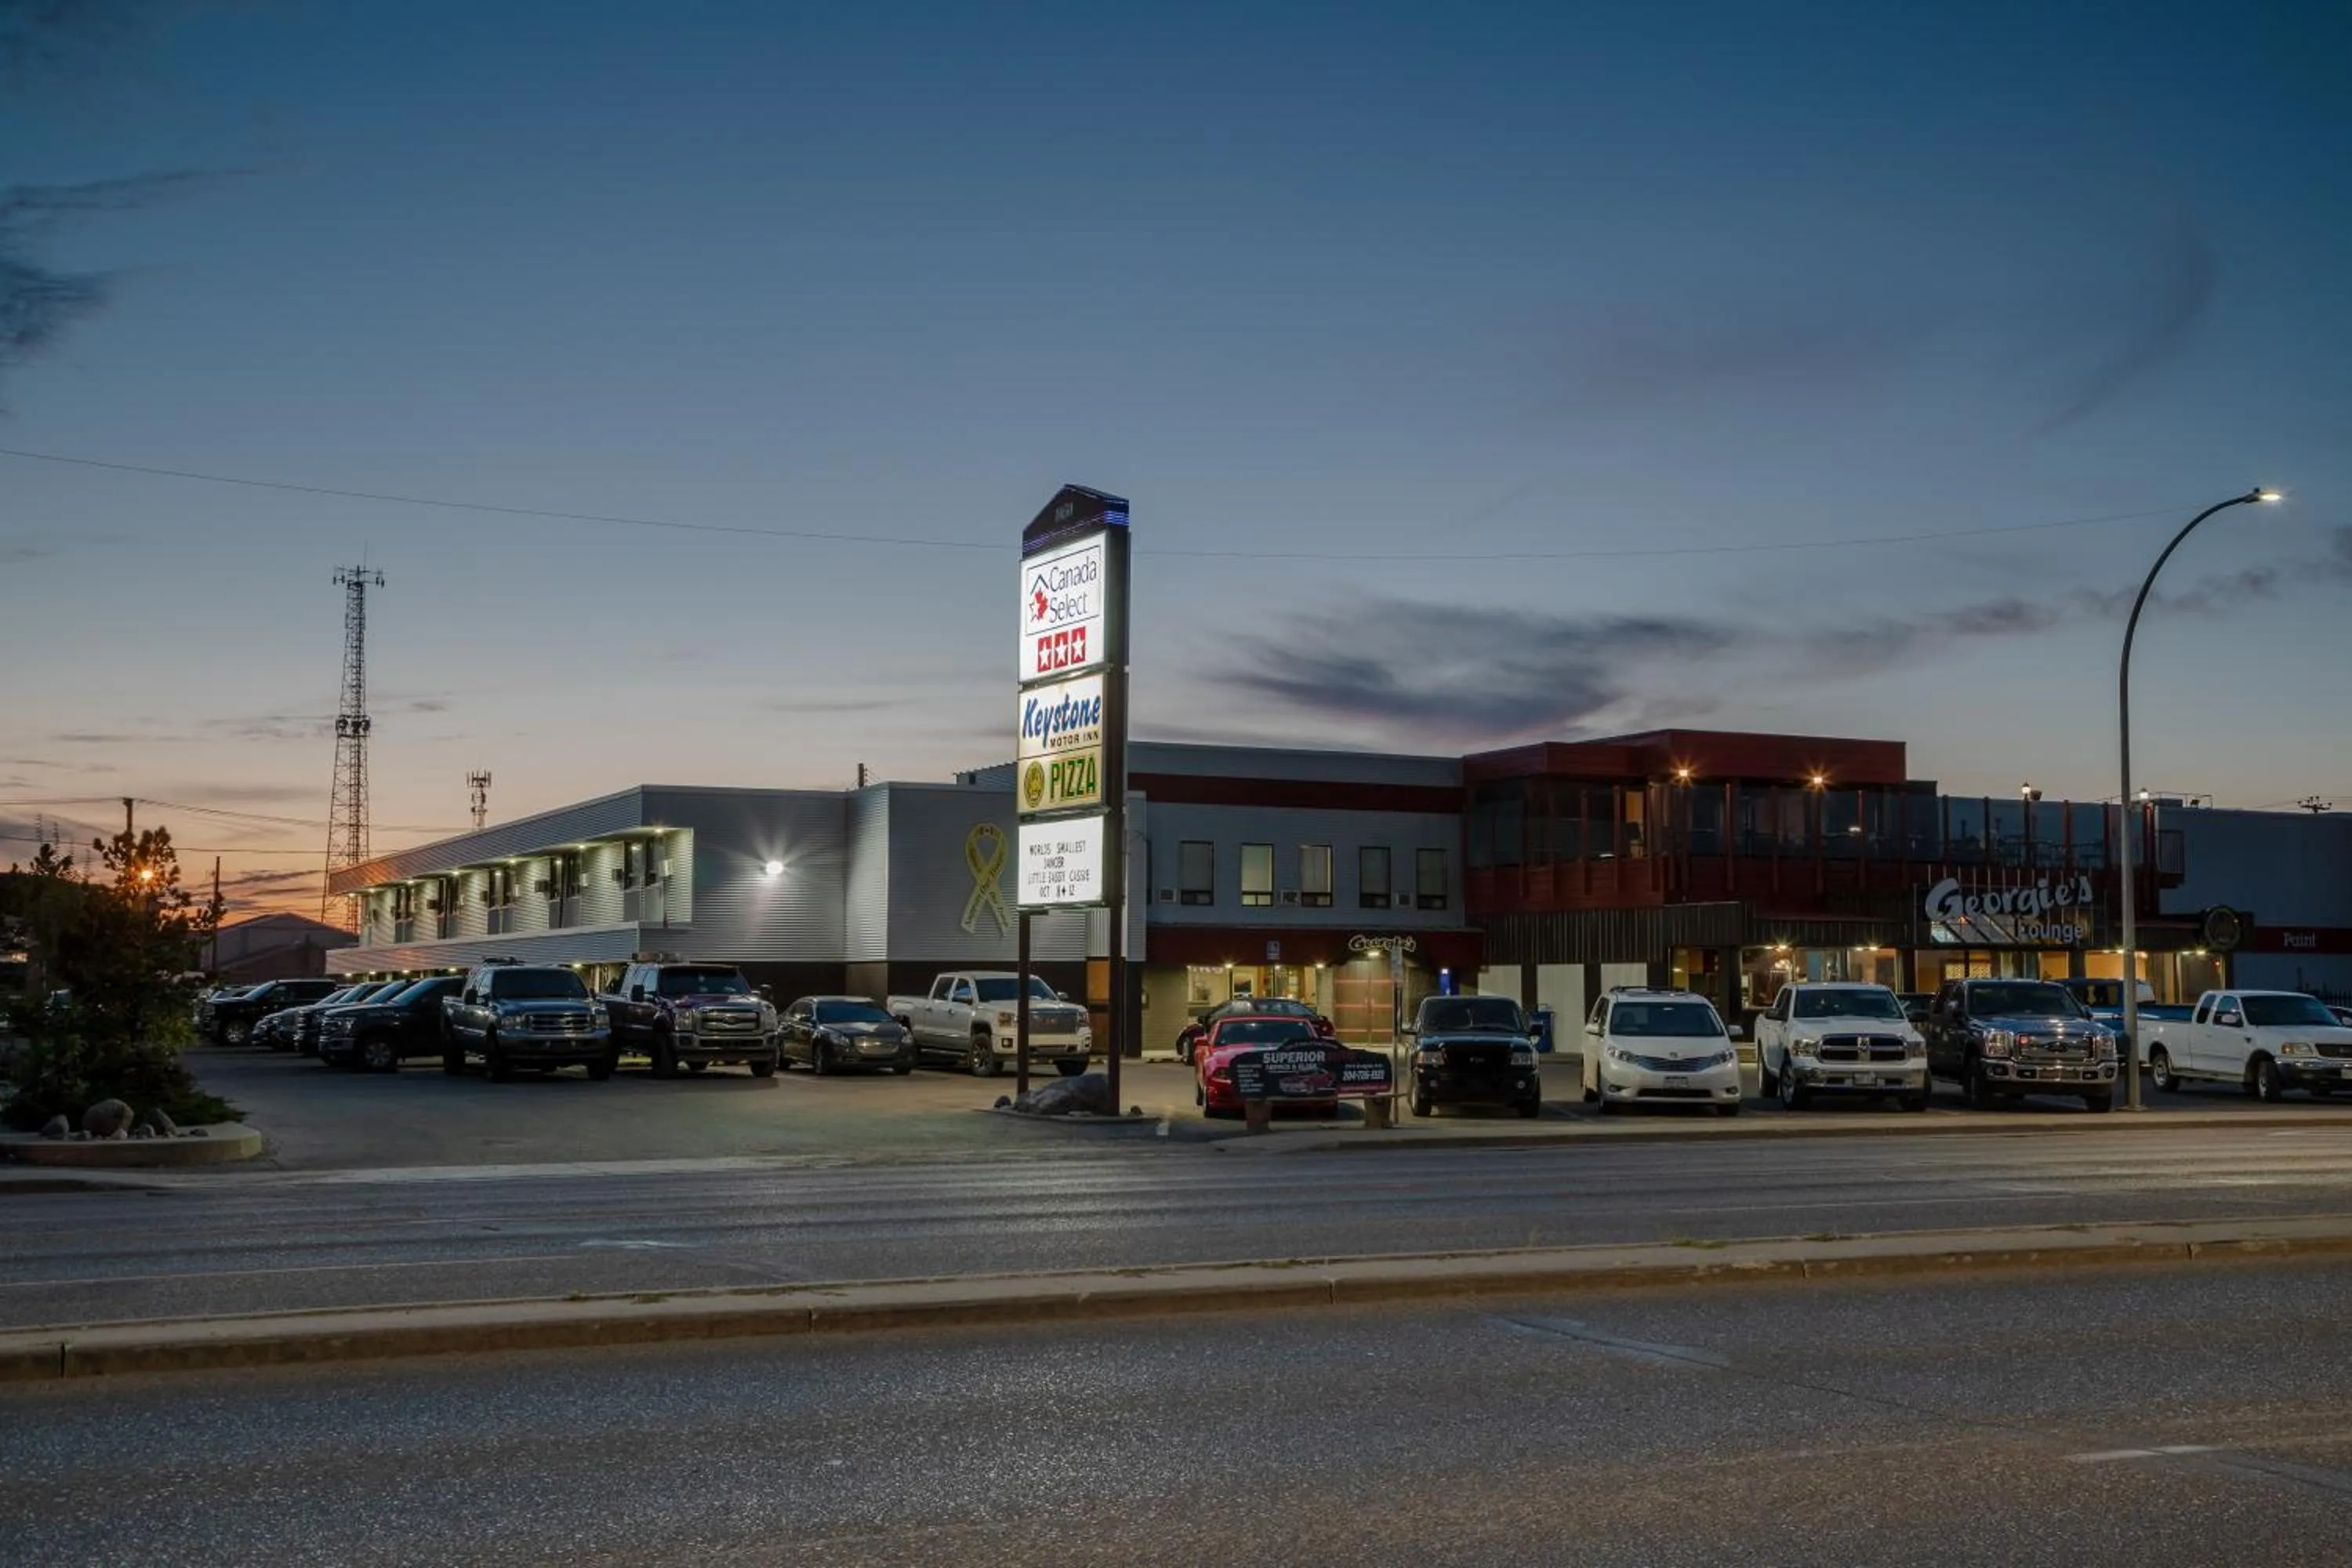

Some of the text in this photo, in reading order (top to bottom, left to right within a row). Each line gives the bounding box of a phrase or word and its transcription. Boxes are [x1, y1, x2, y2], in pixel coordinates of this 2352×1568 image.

[1049, 556, 1097, 593] Canada
[1049, 592, 1088, 623] Select
[1022, 693, 1101, 748] Keystone
[1050, 731, 1099, 748] MOTOR INN
[1049, 753, 1096, 800] PIZZA
[1057, 840, 1086, 854] SMALLEST
[1040, 885, 1050, 898] OCT
[1925, 876, 2092, 922] Georgie's
[1262, 1050, 1326, 1064] SUPERIOR
